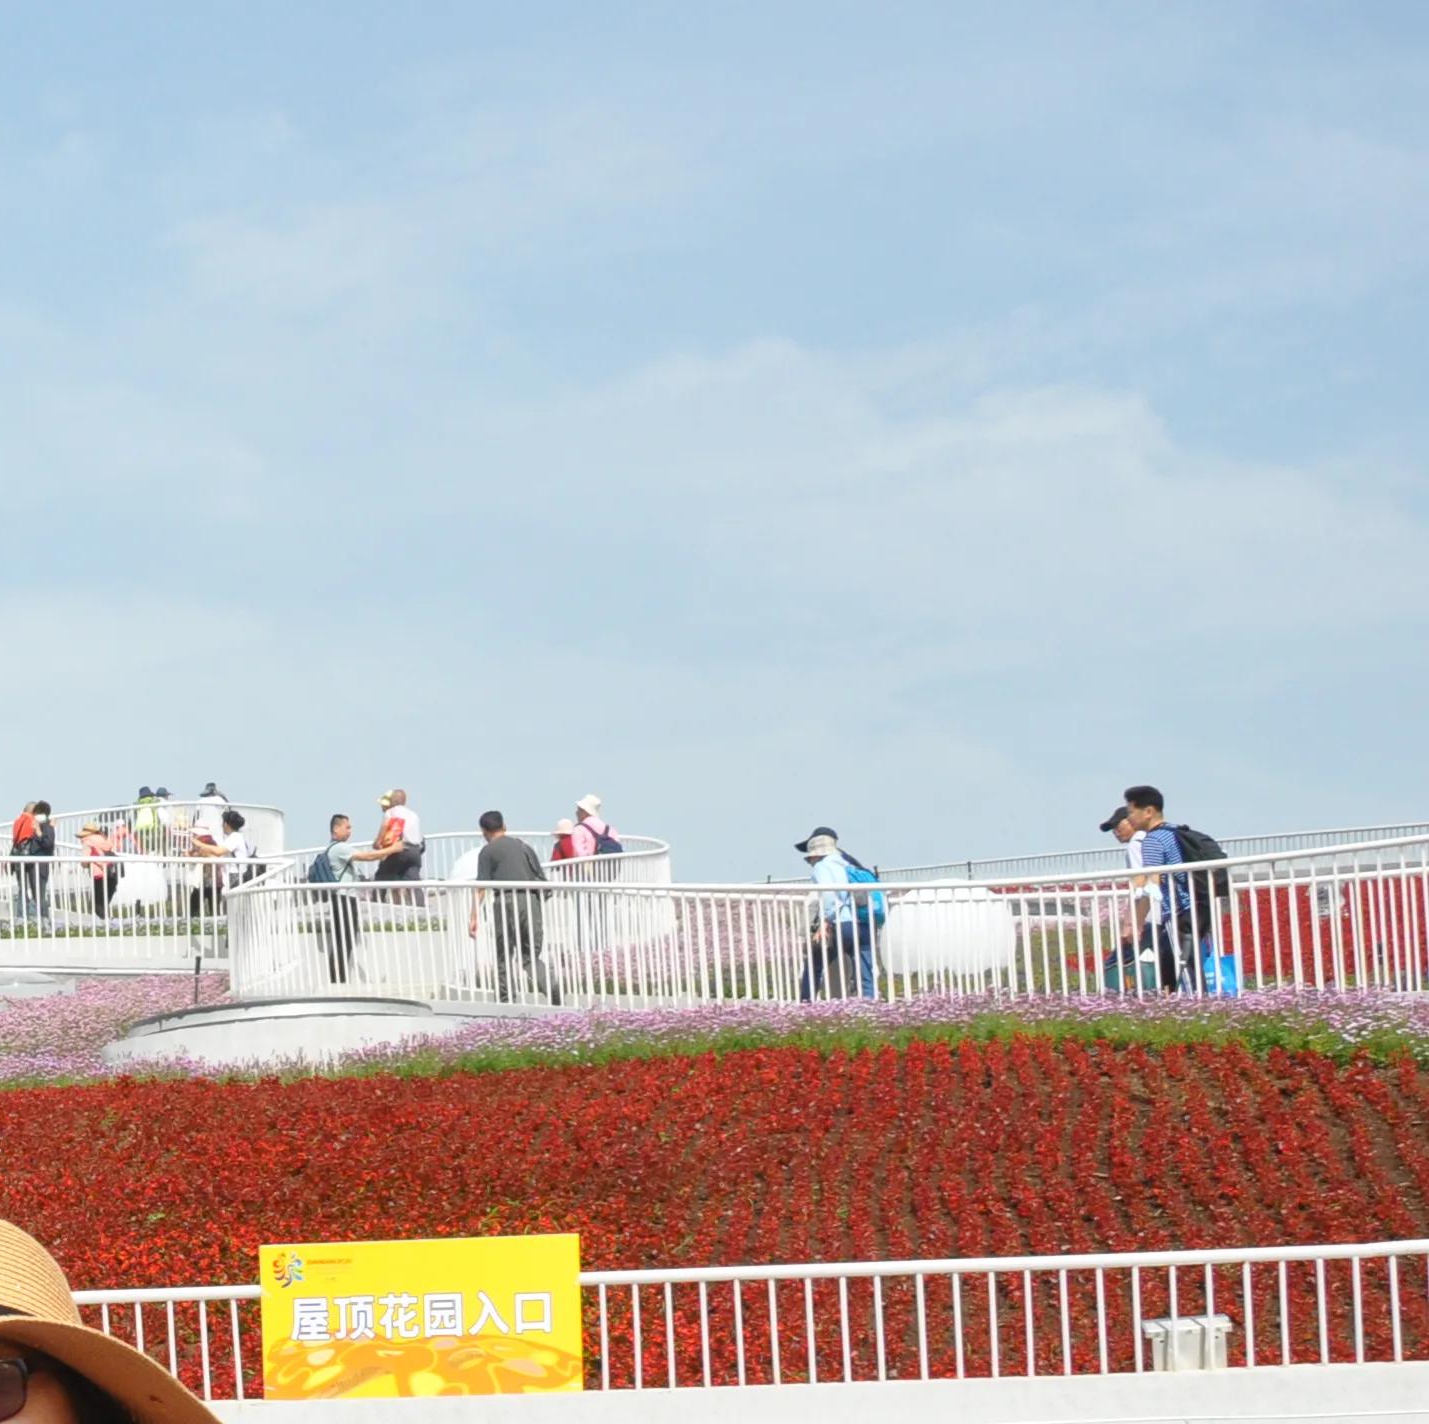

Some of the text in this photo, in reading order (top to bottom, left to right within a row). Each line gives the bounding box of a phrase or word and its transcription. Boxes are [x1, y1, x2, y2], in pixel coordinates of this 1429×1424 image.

[291, 1291, 552, 1341] 屋顶花园入口
